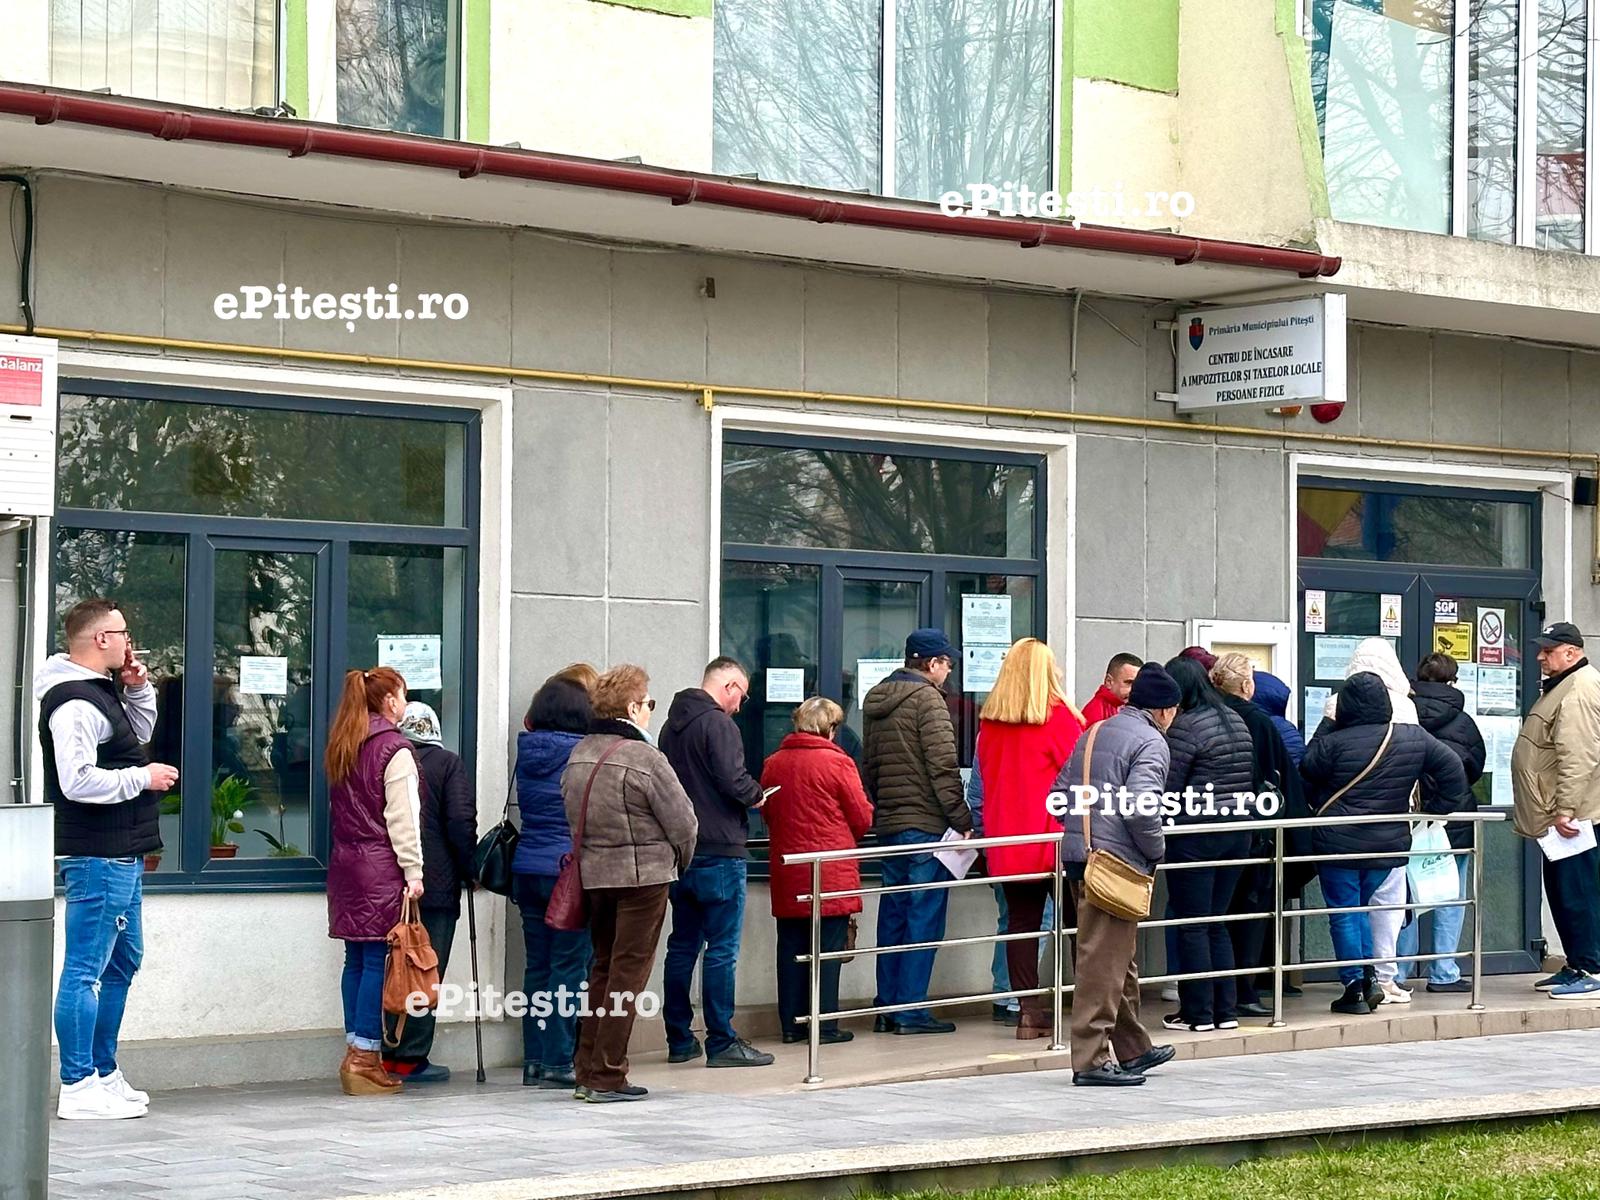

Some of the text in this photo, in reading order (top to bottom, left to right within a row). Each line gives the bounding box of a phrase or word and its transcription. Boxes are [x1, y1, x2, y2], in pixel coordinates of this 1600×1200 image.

[1242, 318, 1289, 331] Municipiului
[1208, 346, 1294, 366] CENTRU DE ÎNCASARE
[0, 357, 42, 373] Galanz
[1181, 362, 1322, 387] A IMPOZITELOR ȘI TAXELOR LOCALE
[1216, 385, 1284, 402] PERSOANE FIZICE
[1435, 601, 1458, 613] SGPI
